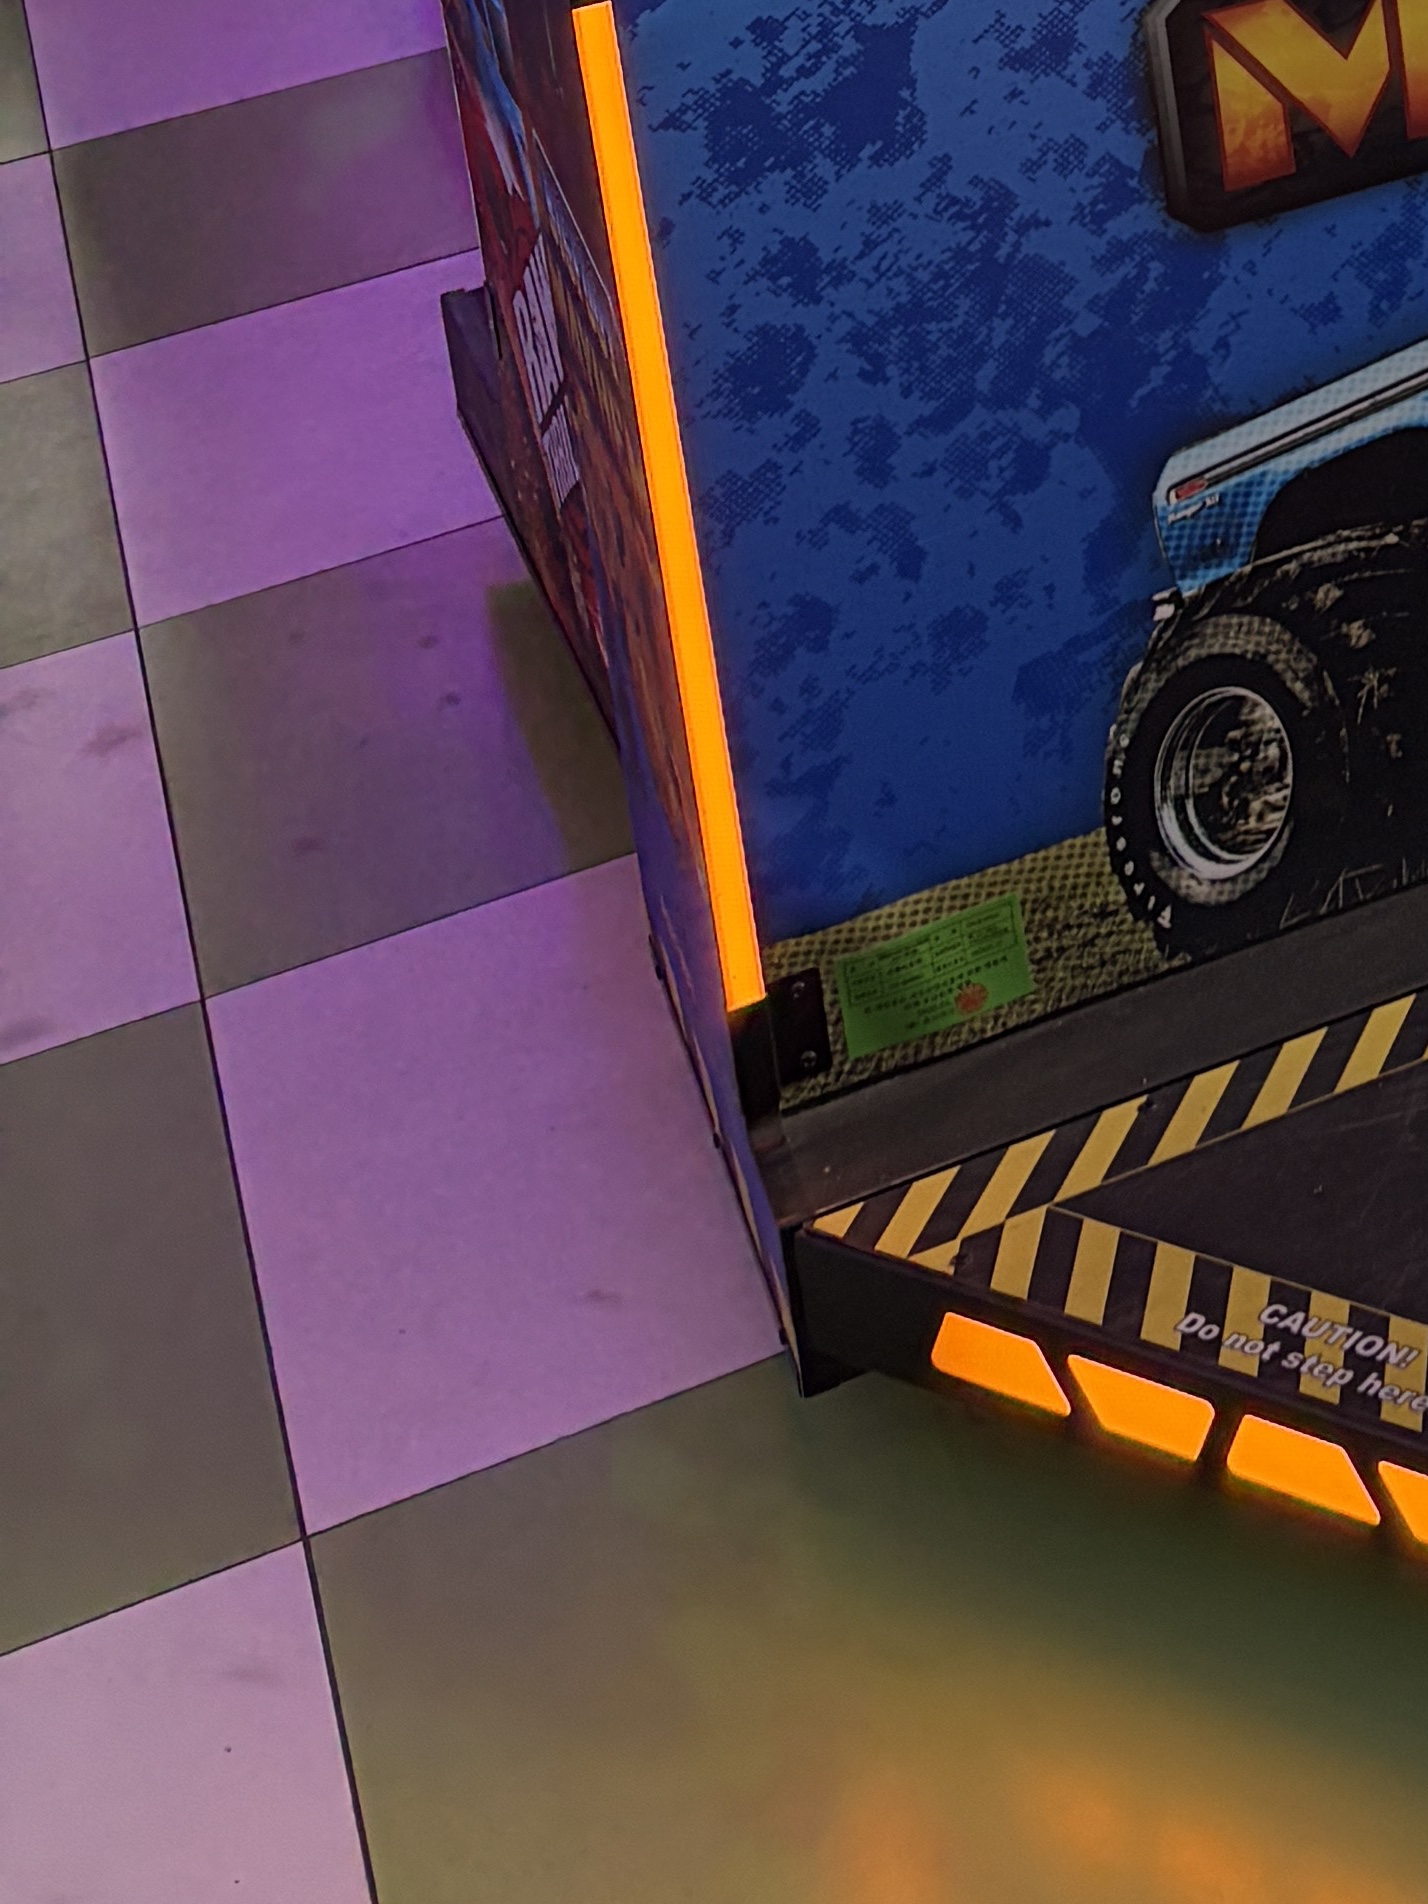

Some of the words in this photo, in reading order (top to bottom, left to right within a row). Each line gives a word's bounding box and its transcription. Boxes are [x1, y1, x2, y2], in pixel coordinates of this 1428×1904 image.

[1174, 1311, 1221, 1341] Do
[1222, 1330, 1281, 1361] not
[1281, 1350, 1355, 1387] step
[1258, 1302, 1420, 1370] CAUTION!
